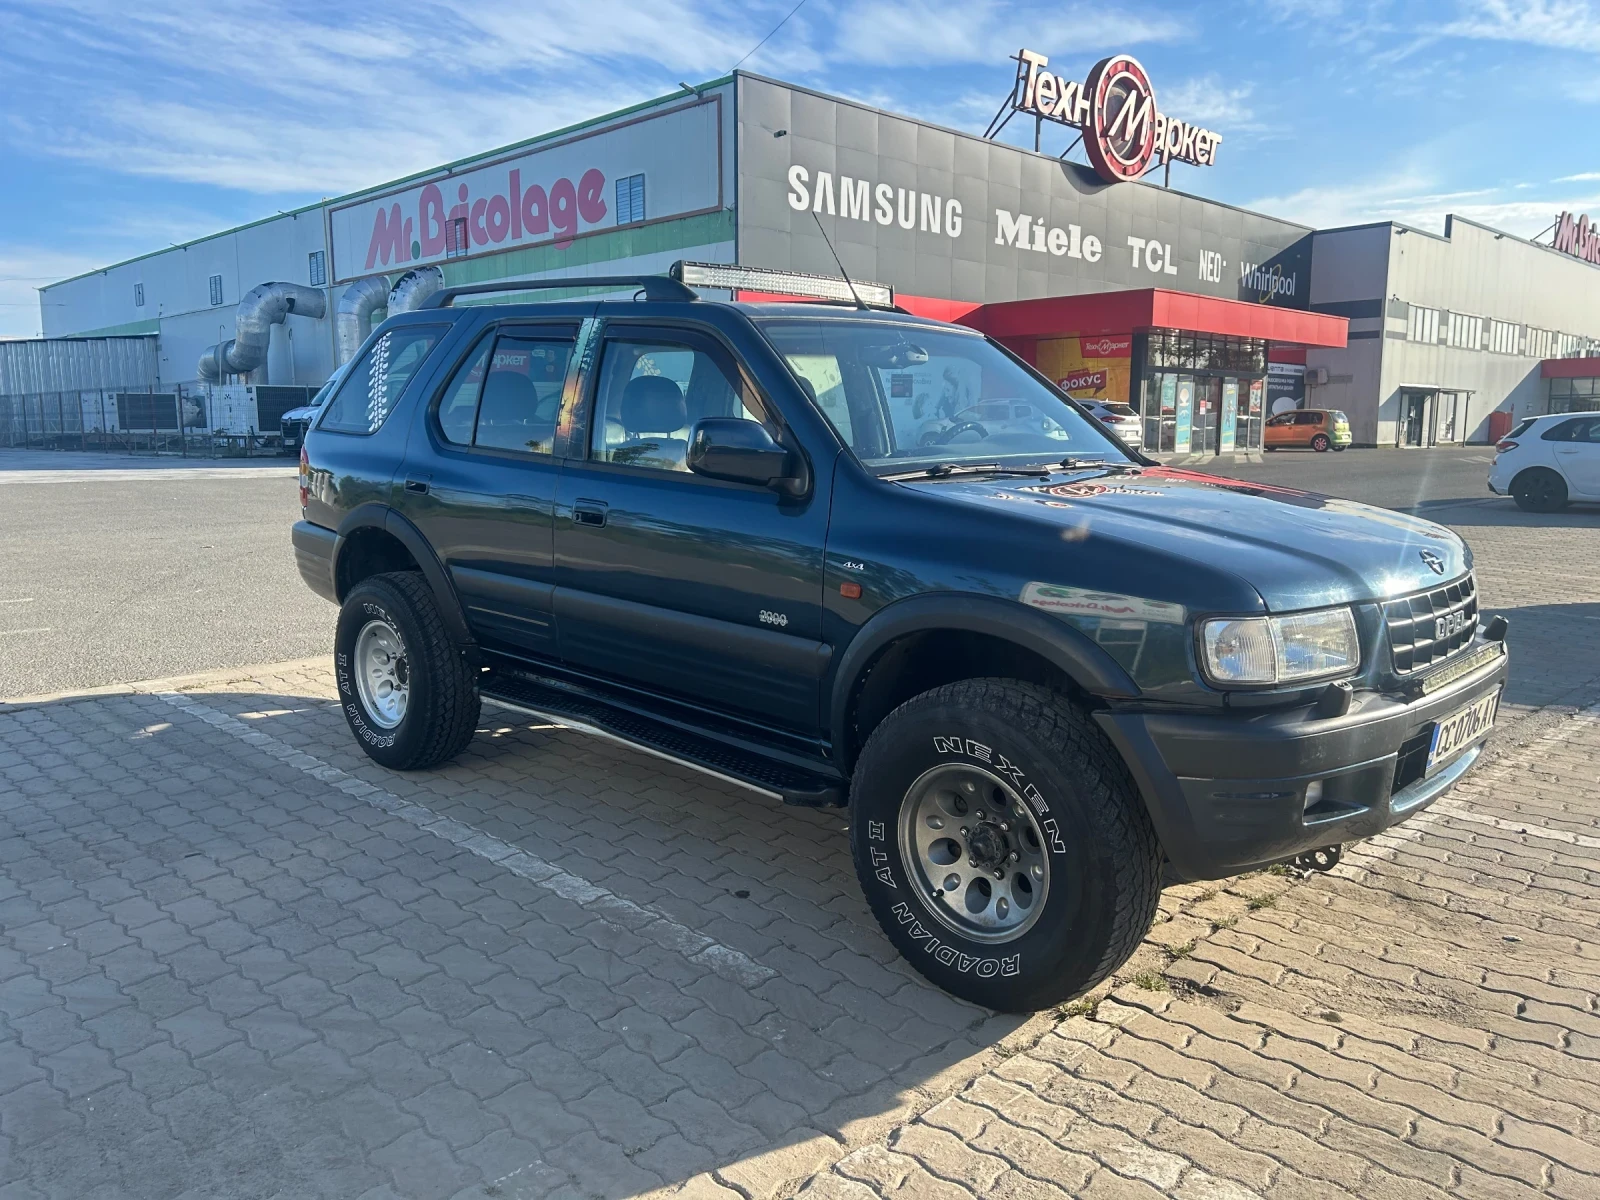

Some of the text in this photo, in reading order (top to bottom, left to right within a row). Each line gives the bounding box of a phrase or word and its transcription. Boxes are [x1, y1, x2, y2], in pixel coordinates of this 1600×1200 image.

[788, 164, 963, 238] SAMSUNG
[995, 208, 1102, 262] Miele
[1127, 236, 1178, 275] TCL
[1240, 261, 1296, 299] Whirlpool
[1060, 374, 1101, 391] ФОКУС
[338, 669, 351, 696] AT
[347, 703, 396, 748] ROADIAN
[933, 736, 1066, 853] NEXEN
[870, 847, 897, 889] AT
[891, 902, 1020, 978] ROADIAN
